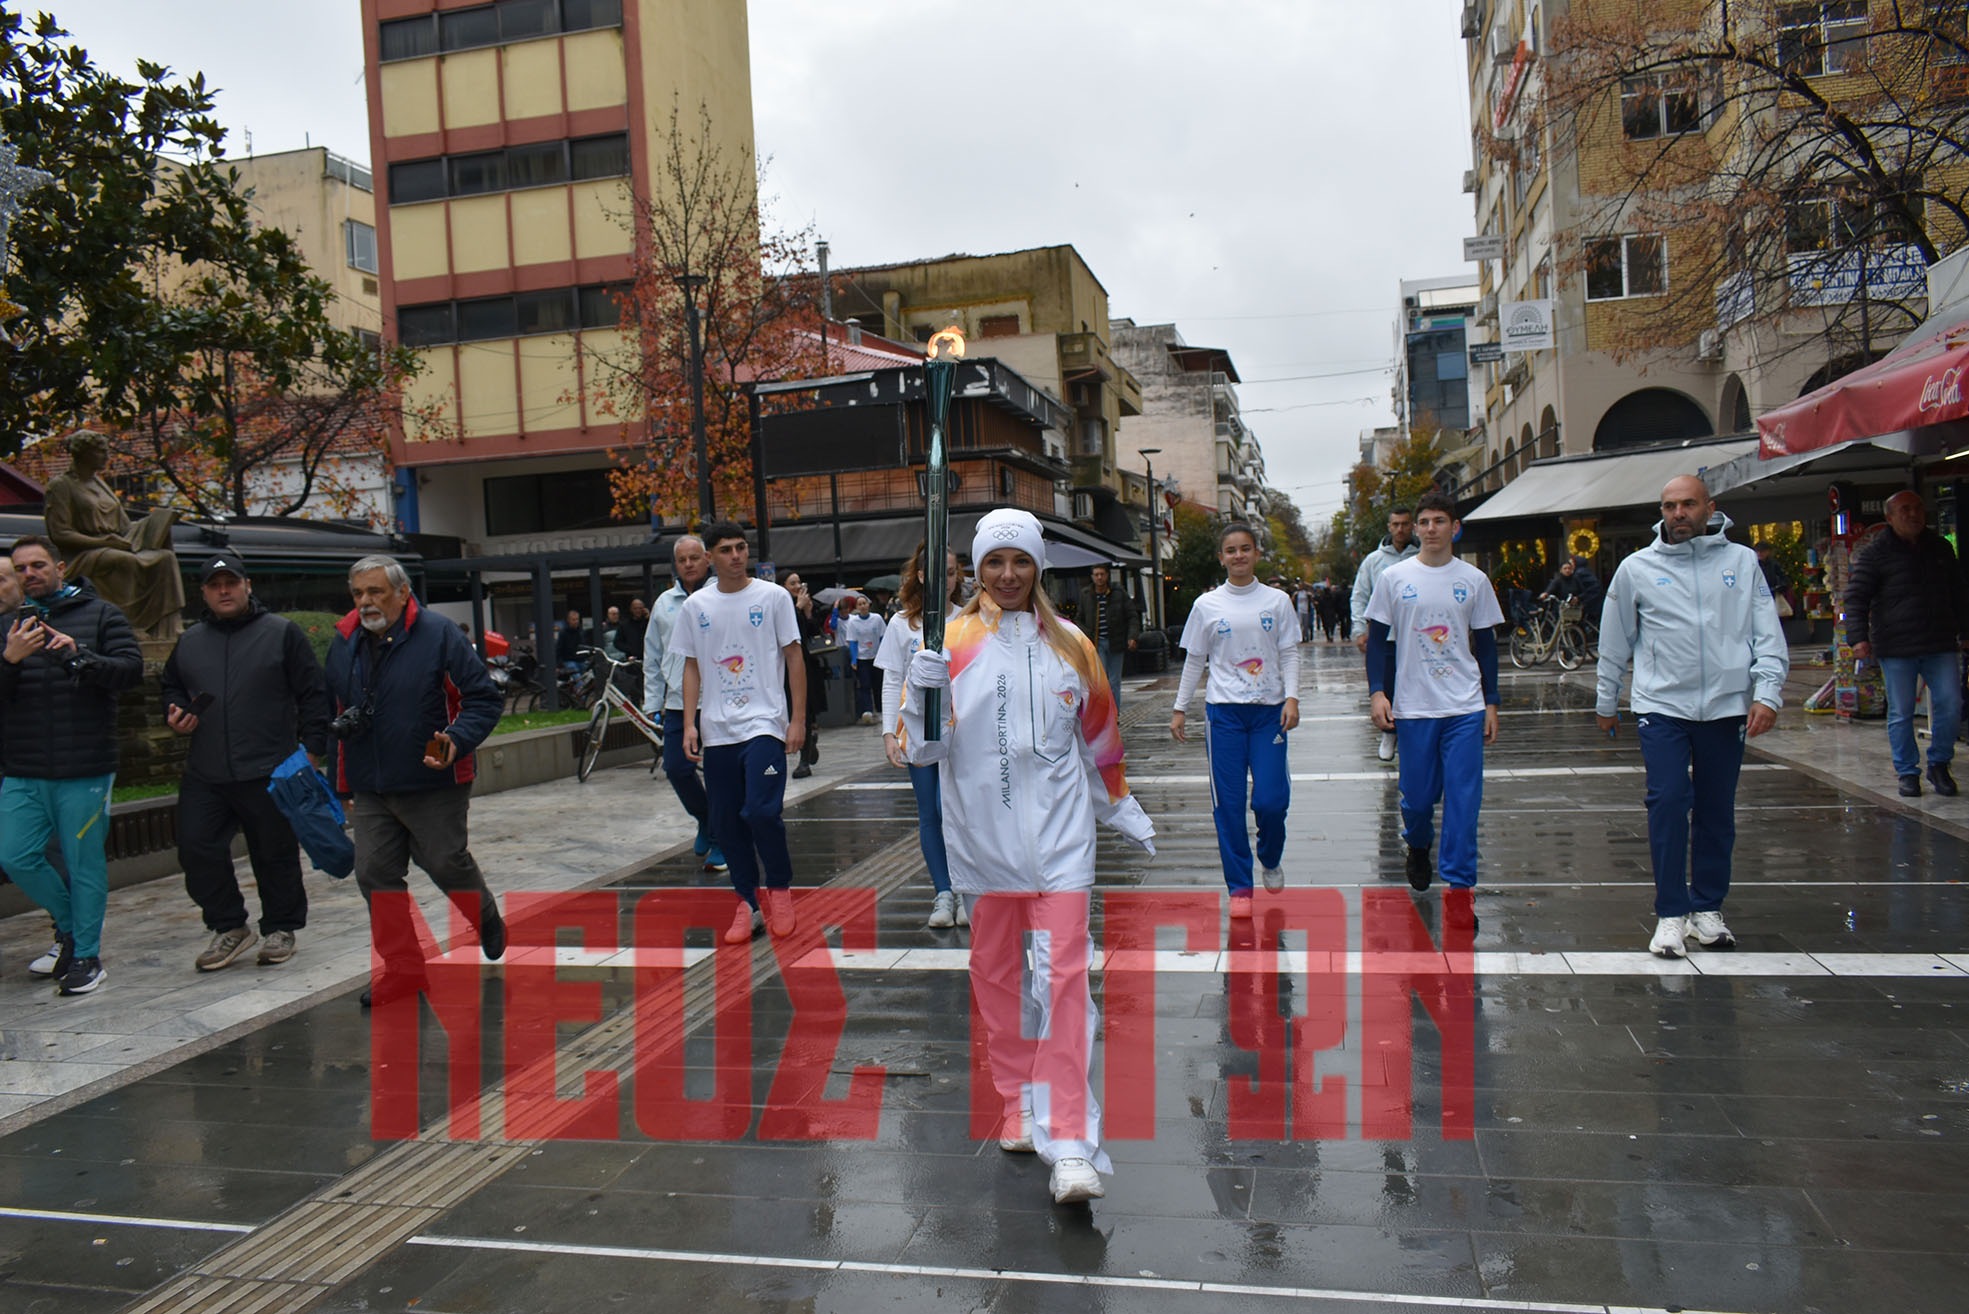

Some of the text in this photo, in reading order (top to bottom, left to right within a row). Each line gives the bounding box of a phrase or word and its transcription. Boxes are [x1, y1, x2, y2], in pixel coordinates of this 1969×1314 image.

[998, 674, 1012, 810] MILANO CORTINA 2026
